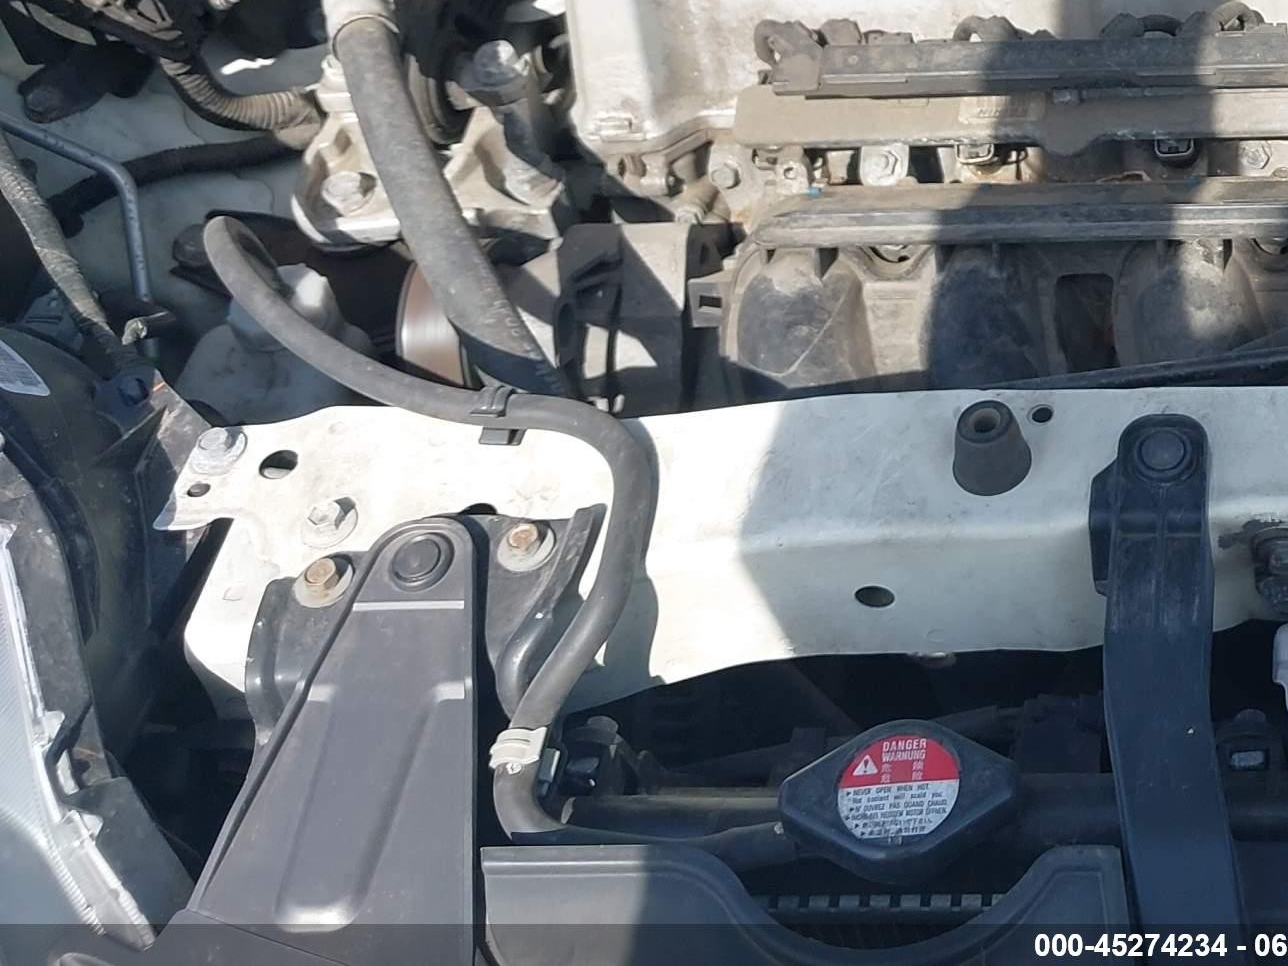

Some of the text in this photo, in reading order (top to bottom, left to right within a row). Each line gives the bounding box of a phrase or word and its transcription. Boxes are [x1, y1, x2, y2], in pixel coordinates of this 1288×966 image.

[882, 738, 927, 752] DANGER
[882, 749, 926, 762] WARNUNG
[876, 786, 891, 794] OPEN
